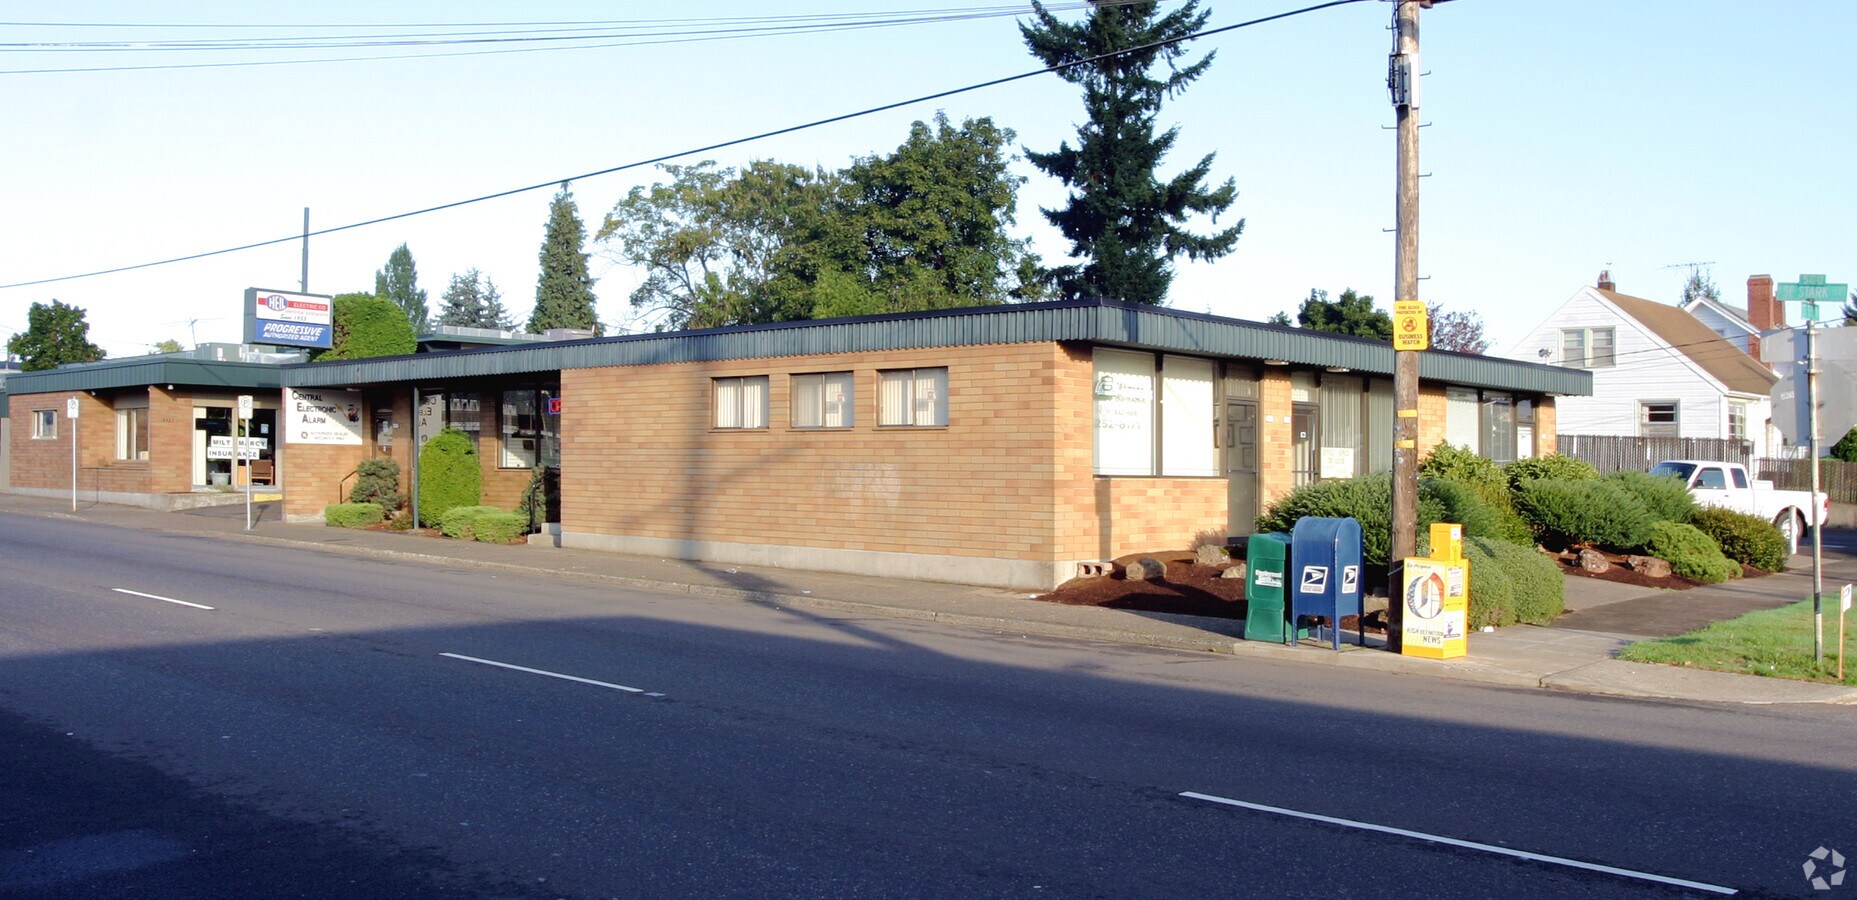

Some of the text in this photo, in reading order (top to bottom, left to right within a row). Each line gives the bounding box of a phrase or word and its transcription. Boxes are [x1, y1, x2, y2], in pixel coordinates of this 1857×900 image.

[1799, 286, 1828, 299] STARK
[268, 295, 286, 310] HEIL
[293, 302, 318, 310] ELECTRIC
[264, 323, 323, 336] PROGRESSIVE
[263, 331, 301, 341] AUTHORIZED
[292, 390, 323, 401] CENTRAL
[297, 402, 337, 413] ELECTRONIC
[302, 414, 326, 424] ALARM
[1423, 635, 1441, 644] NEWS
